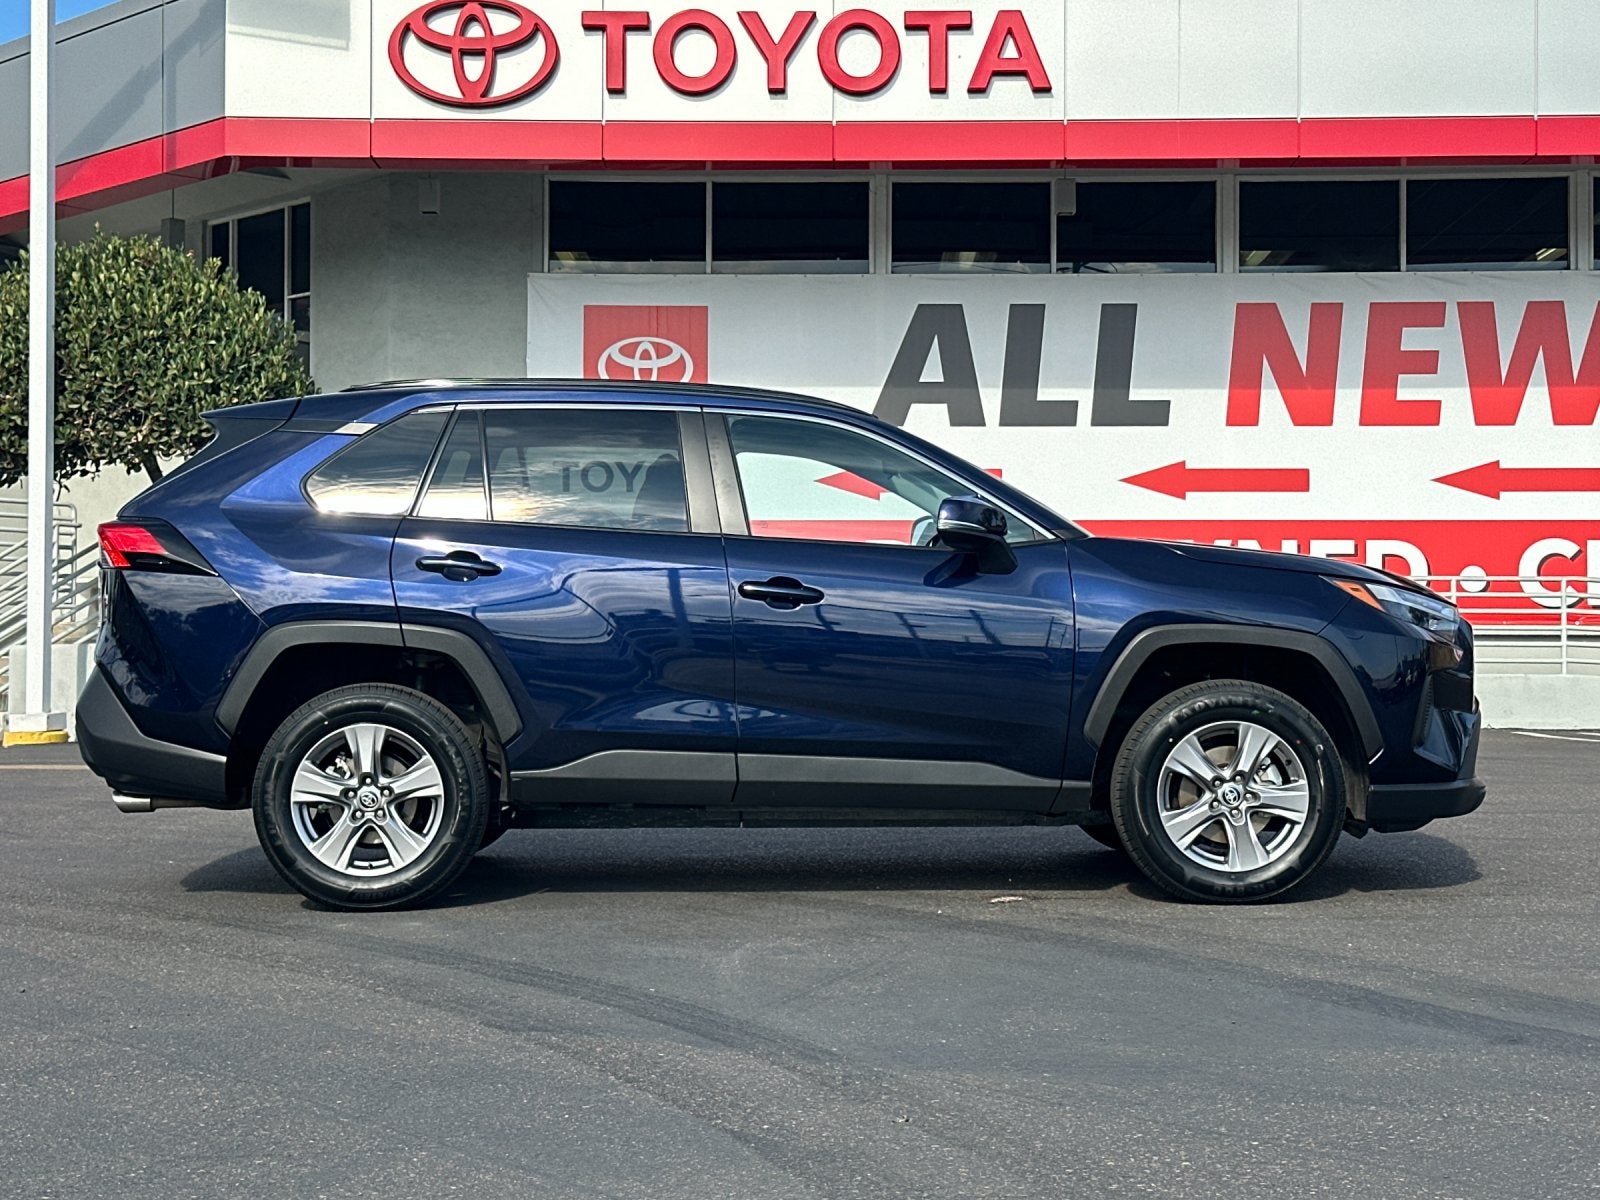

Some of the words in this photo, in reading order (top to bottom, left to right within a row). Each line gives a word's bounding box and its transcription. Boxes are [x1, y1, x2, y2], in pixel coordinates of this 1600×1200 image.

[582, 9, 1052, 95] TOYOTA
[872, 303, 1170, 426] ALL
[1226, 301, 1600, 426] NEW
